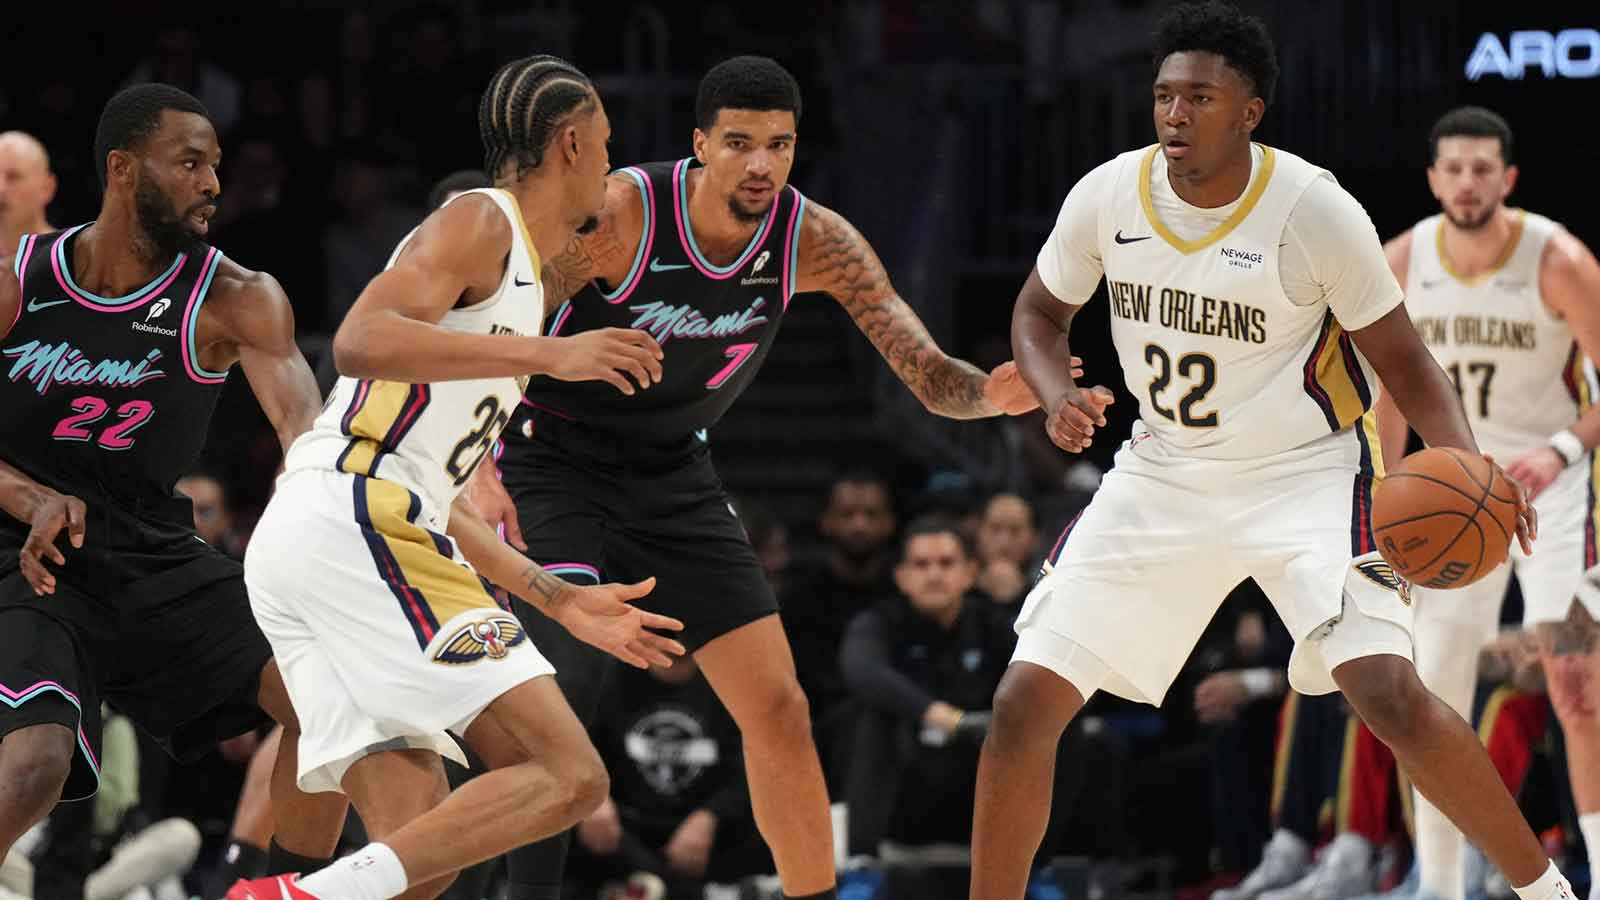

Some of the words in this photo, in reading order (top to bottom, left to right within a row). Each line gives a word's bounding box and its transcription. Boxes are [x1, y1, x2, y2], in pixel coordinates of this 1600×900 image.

[1464, 28, 1600, 80] ARO
[1220, 247, 1263, 264] NEWAGE
[132, 321, 177, 337] Robinhood
[628, 297, 767, 345] Miami
[1110, 280, 1152, 323] NEW
[1159, 288, 1267, 344] ORLEANS
[1454, 315, 1536, 350] ORLEANS
[3, 340, 167, 396] Miami
[705, 343, 759, 390] 7
[1144, 343, 1219, 428] 22
[52, 395, 156, 451] 22
